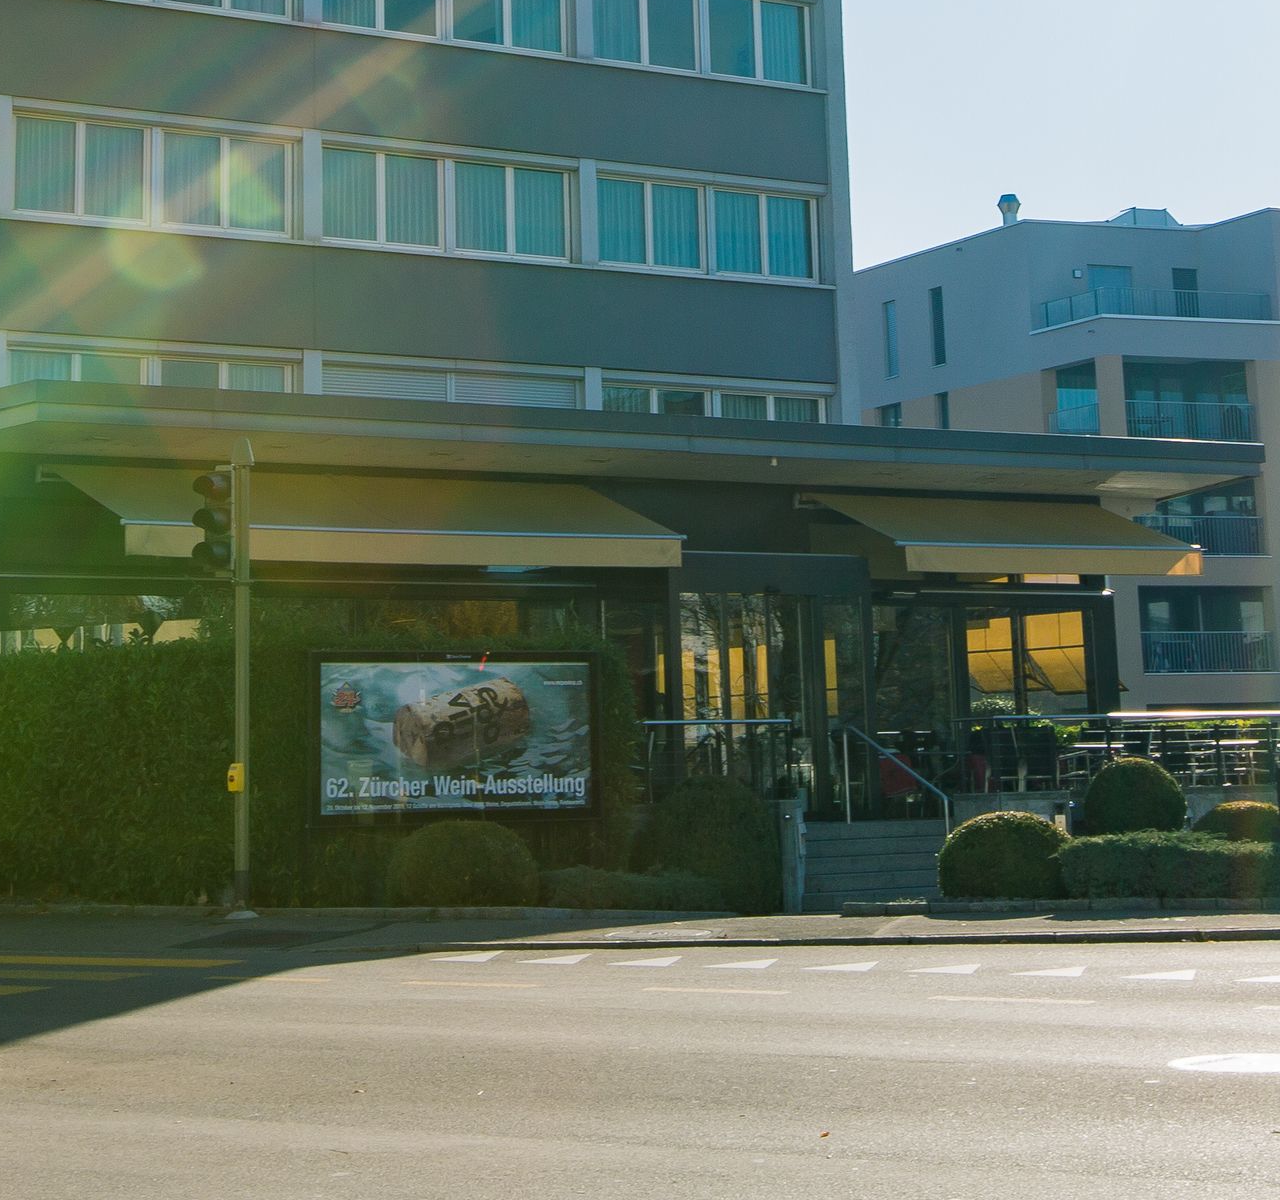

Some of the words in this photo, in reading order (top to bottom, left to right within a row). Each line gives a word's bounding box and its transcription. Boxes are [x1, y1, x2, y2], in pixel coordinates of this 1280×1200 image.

[325, 777, 354, 798] 62.
[359, 776, 429, 798] Zürcher
[434, 773, 586, 796] Wein-Ausstellung
